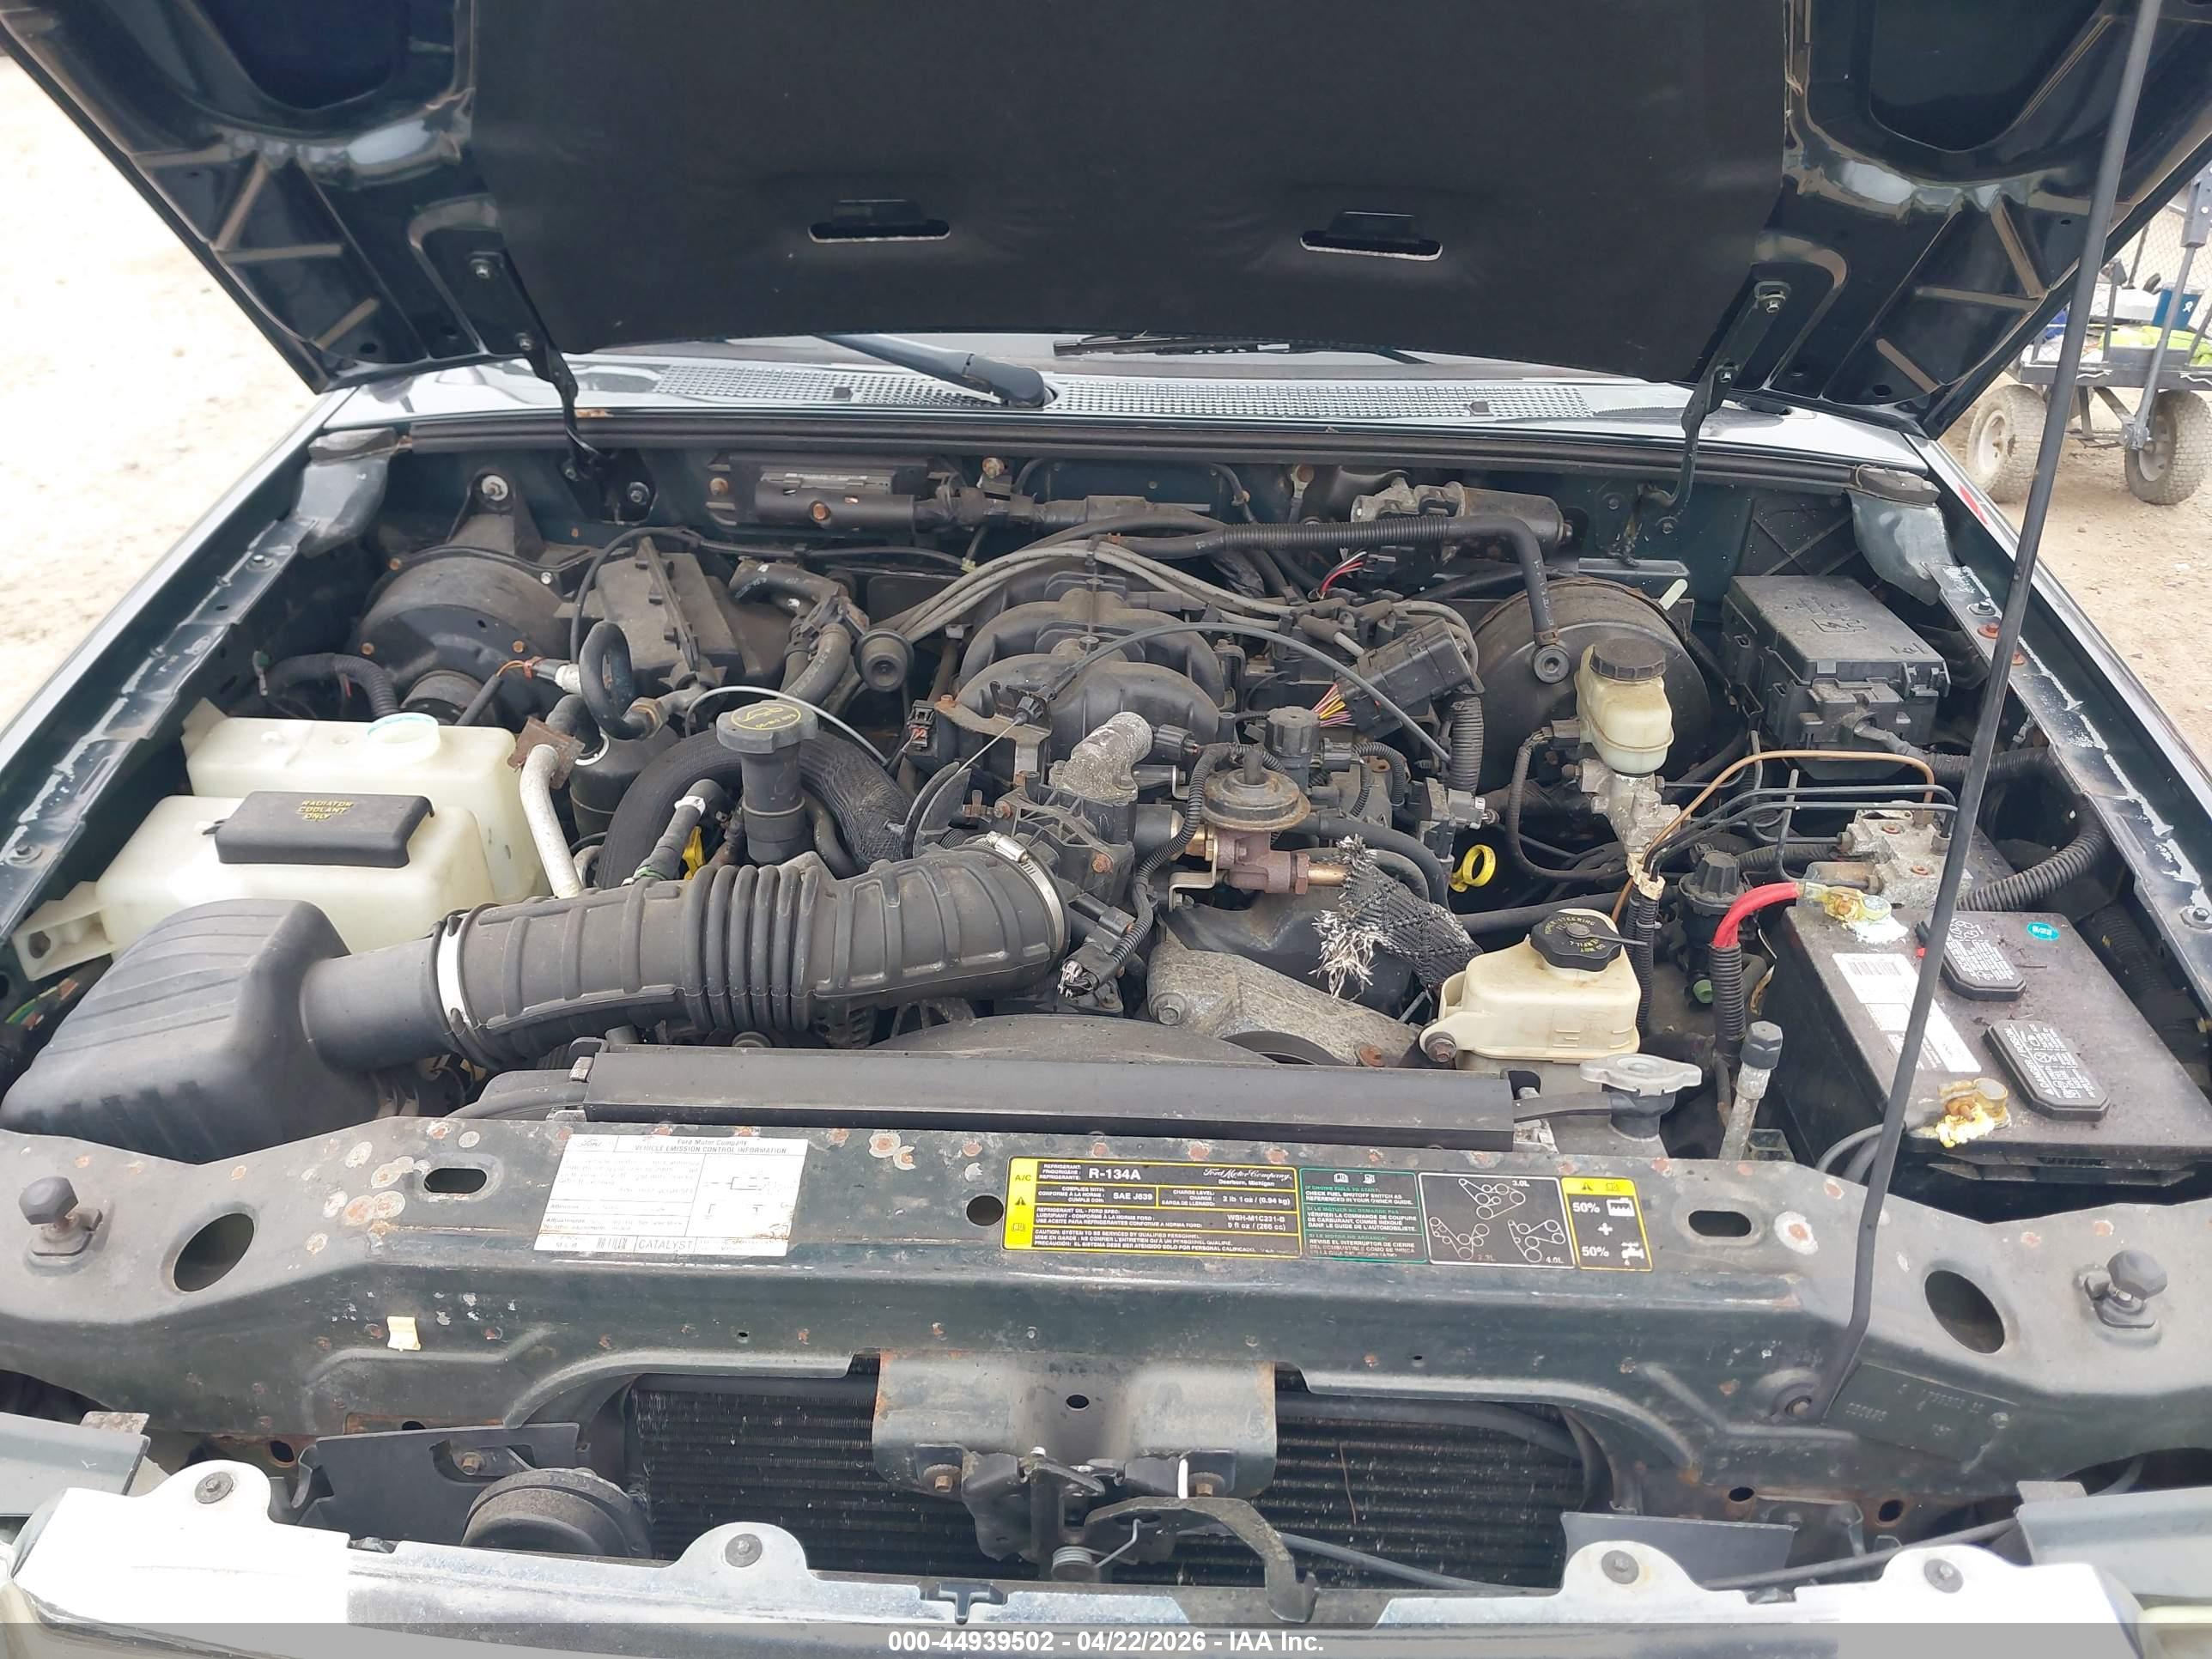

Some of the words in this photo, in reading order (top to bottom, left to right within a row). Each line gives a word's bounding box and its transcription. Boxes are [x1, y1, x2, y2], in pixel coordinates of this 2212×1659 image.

[301, 799, 355, 808] RADIATOR
[1088, 1167, 1141, 1180] R-134A
[1571, 1201, 1601, 1212] 50%
[638, 1239, 693, 1249] CATALYST
[1580, 1245, 1610, 1257] 50%
